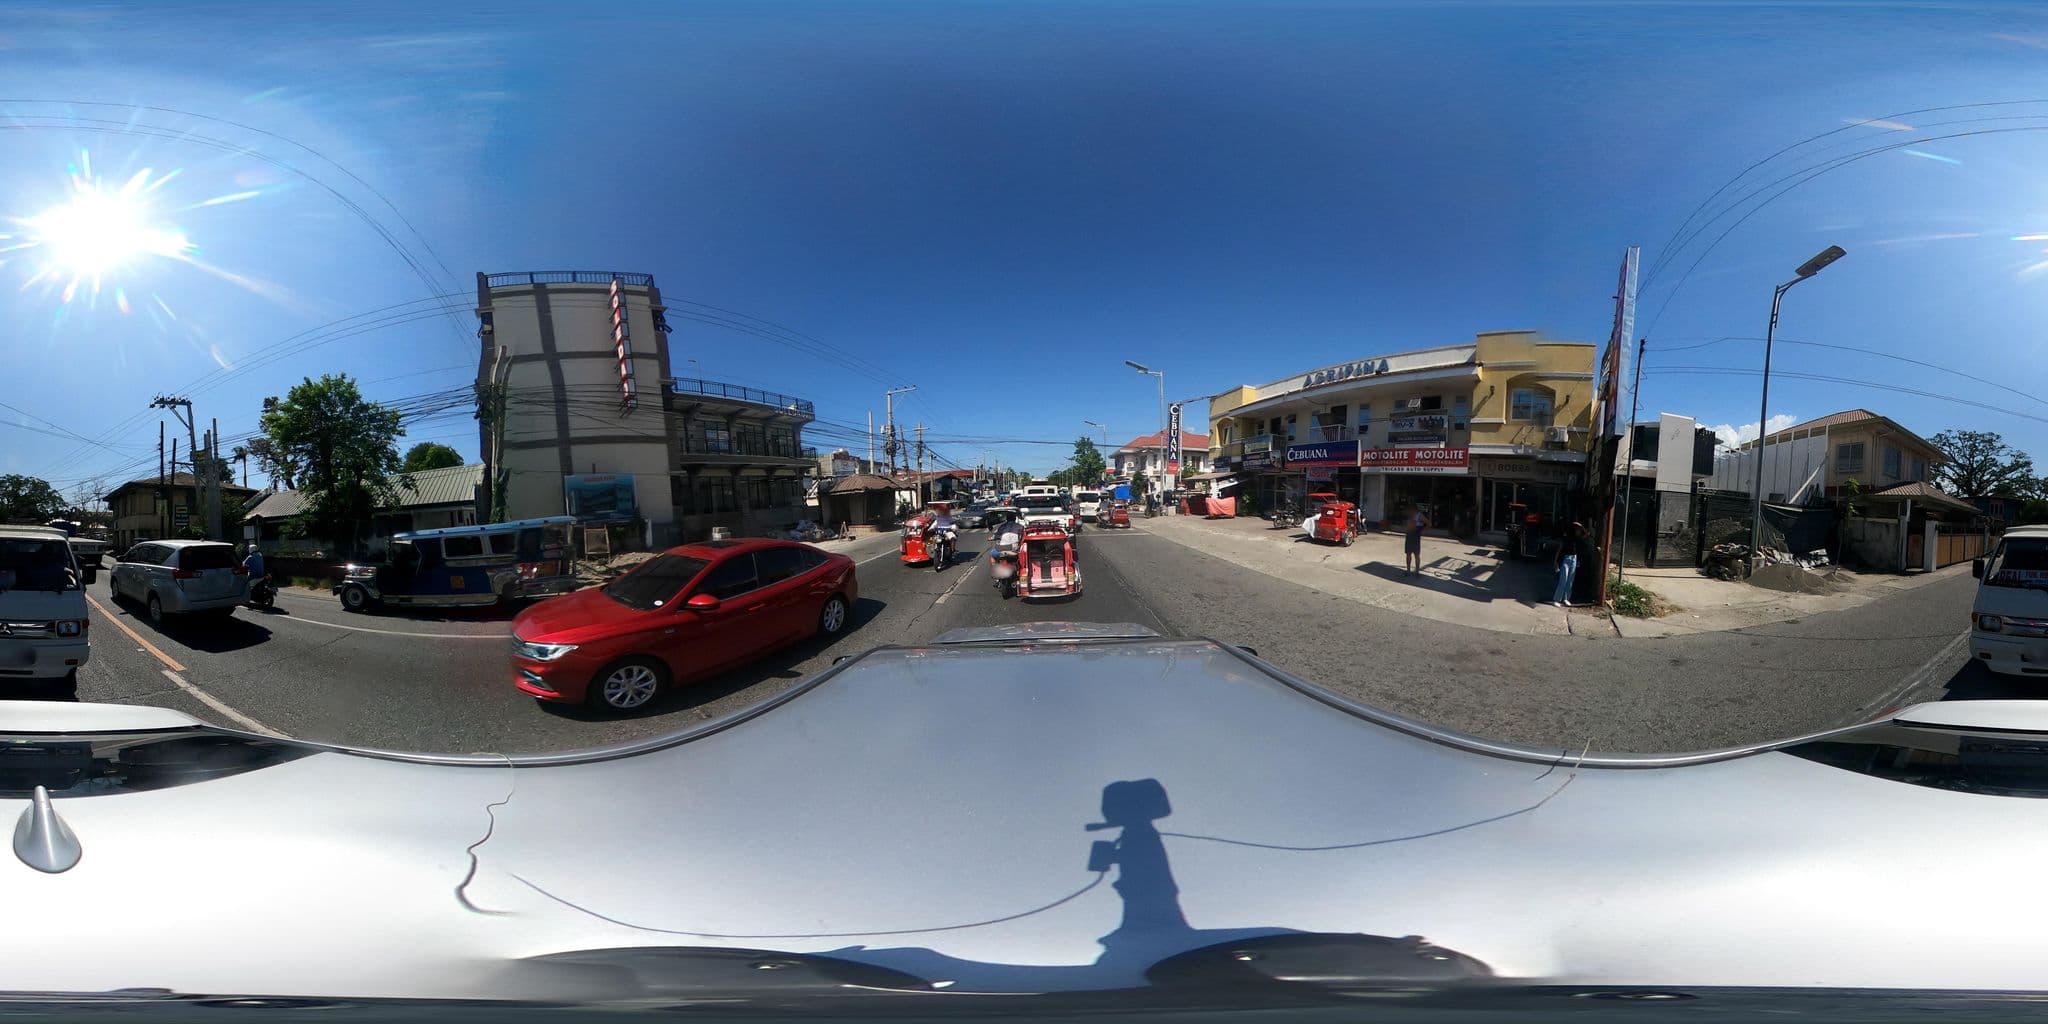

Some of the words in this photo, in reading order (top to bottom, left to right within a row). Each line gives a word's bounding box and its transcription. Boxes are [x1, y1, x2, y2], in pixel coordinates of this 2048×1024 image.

[1303, 359, 1389, 388] AGRIPINA
[1363, 451, 1409, 460] MOTOLITE
[1415, 450, 1463, 459] MOTOLITE
